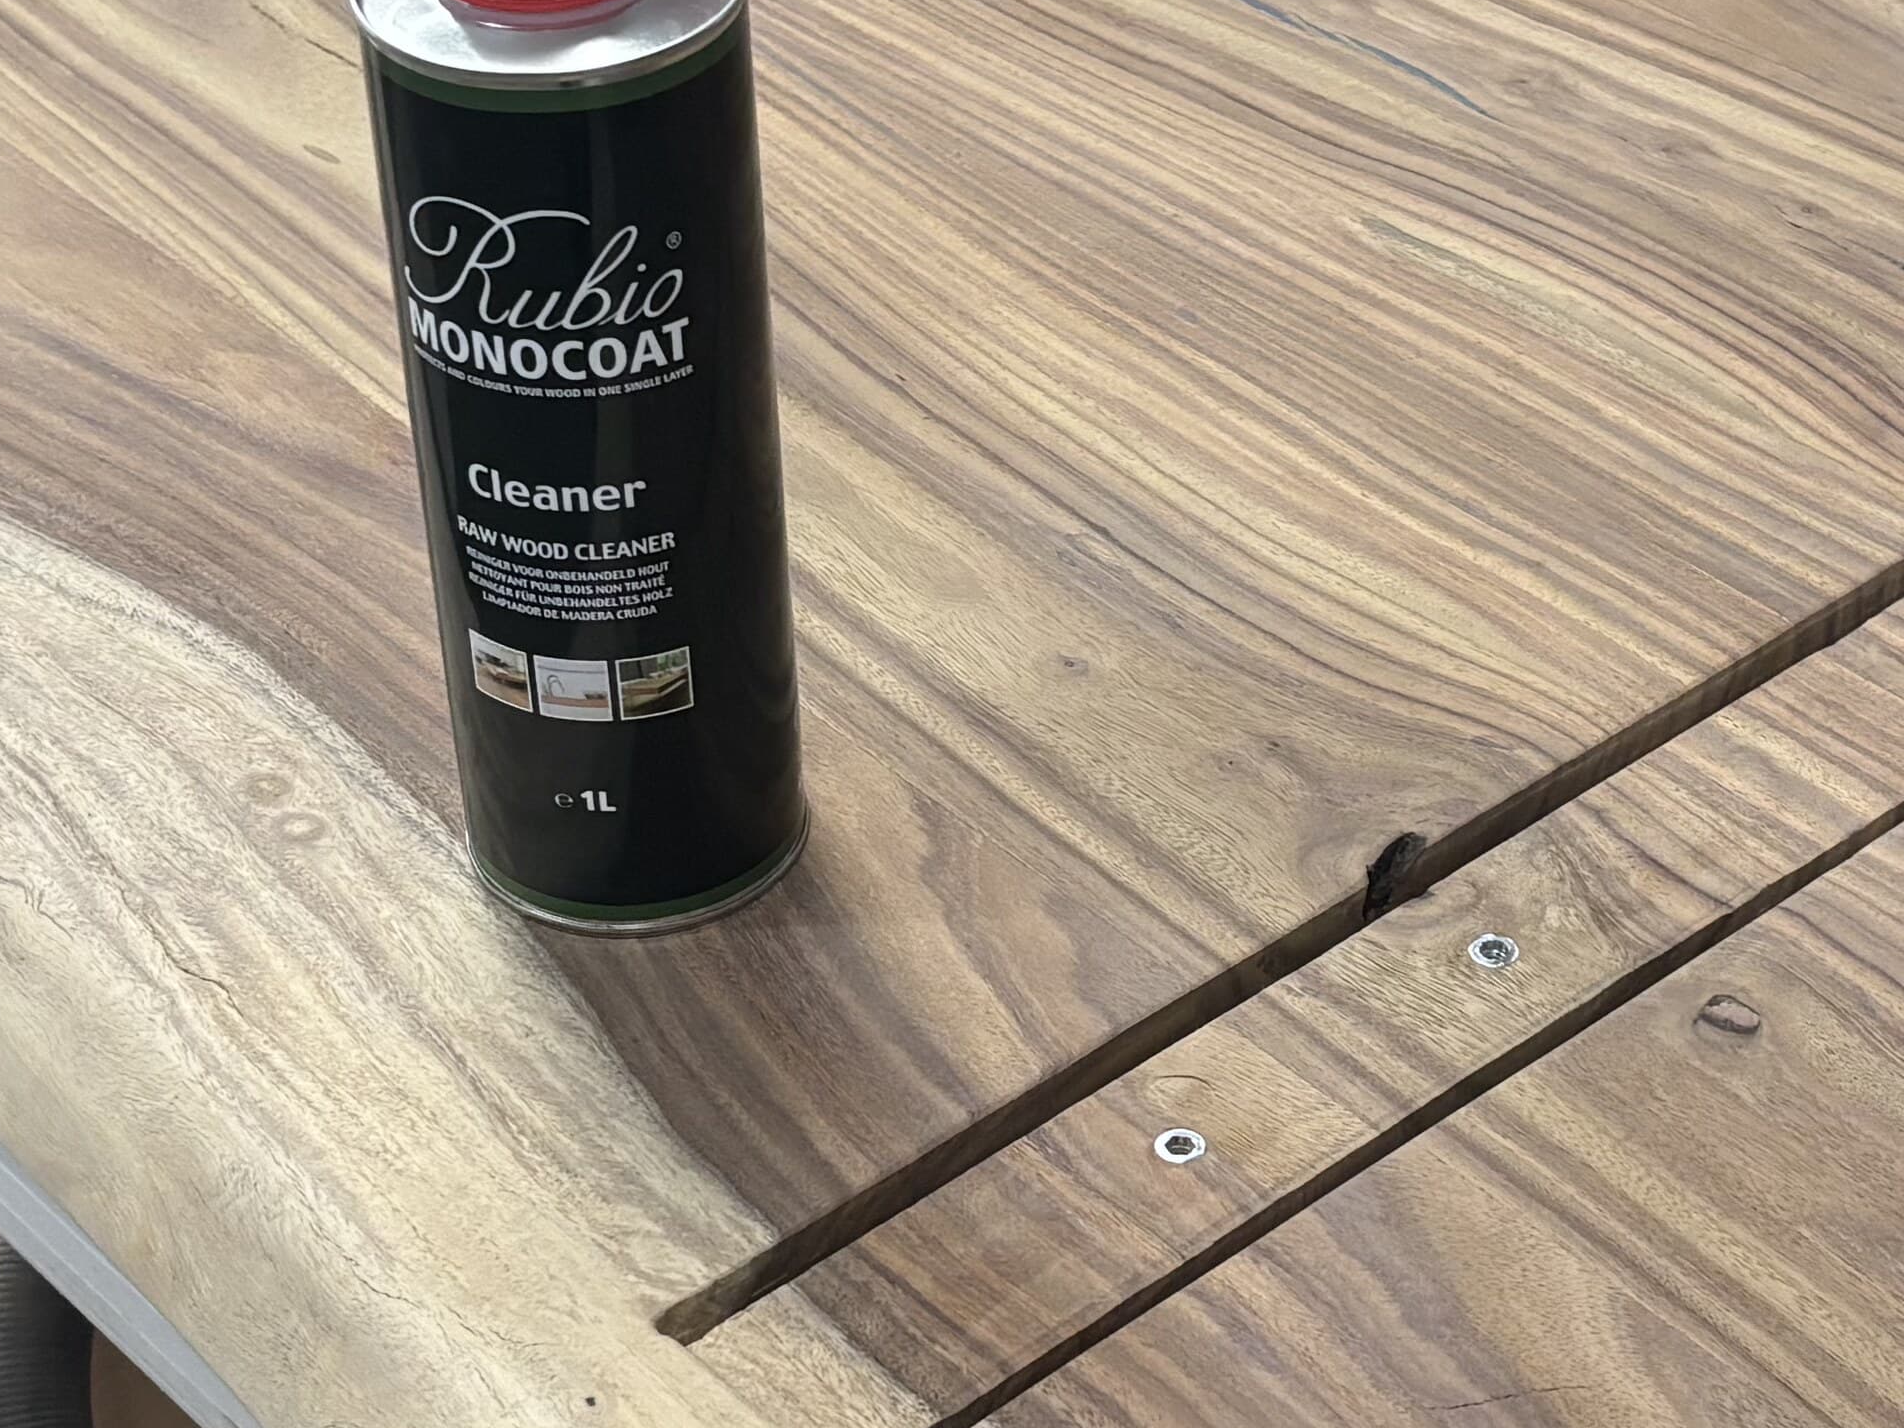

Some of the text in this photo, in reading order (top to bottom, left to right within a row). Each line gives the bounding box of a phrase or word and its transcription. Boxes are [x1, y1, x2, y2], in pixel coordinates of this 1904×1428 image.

[404, 196, 684, 331] Rubio
[407, 297, 689, 381] MONOCOAT
[512, 385, 544, 397] YOUR
[544, 388, 581, 398] WOOD
[583, 388, 596, 397] IN
[598, 385, 623, 396] ONE
[624, 376, 662, 393] SINGLE
[663, 364, 694, 383] LAYER
[467, 463, 647, 512] Cleaner
[457, 514, 676, 561] RAW WOOD CLEANER
[512, 563, 544, 578] VOOR
[545, 567, 636, 582] ONBEHANDELD
[637, 560, 670, 577] HOUT
[530, 580, 562, 594] POUR
[564, 584, 594, 595] BOIS
[596, 583, 623, 595] NON
[624, 573, 666, 592] TRAITÉ
[515, 589, 537, 604] FÜR
[538, 594, 640, 608] UNBEHANDELTES
[642, 586, 674, 603] HOLZ
[543, 608, 561, 620] DE
[561, 610, 615, 621] MADERA
[616, 604, 658, 620] CRUDA
[581, 790, 617, 813] 1L
